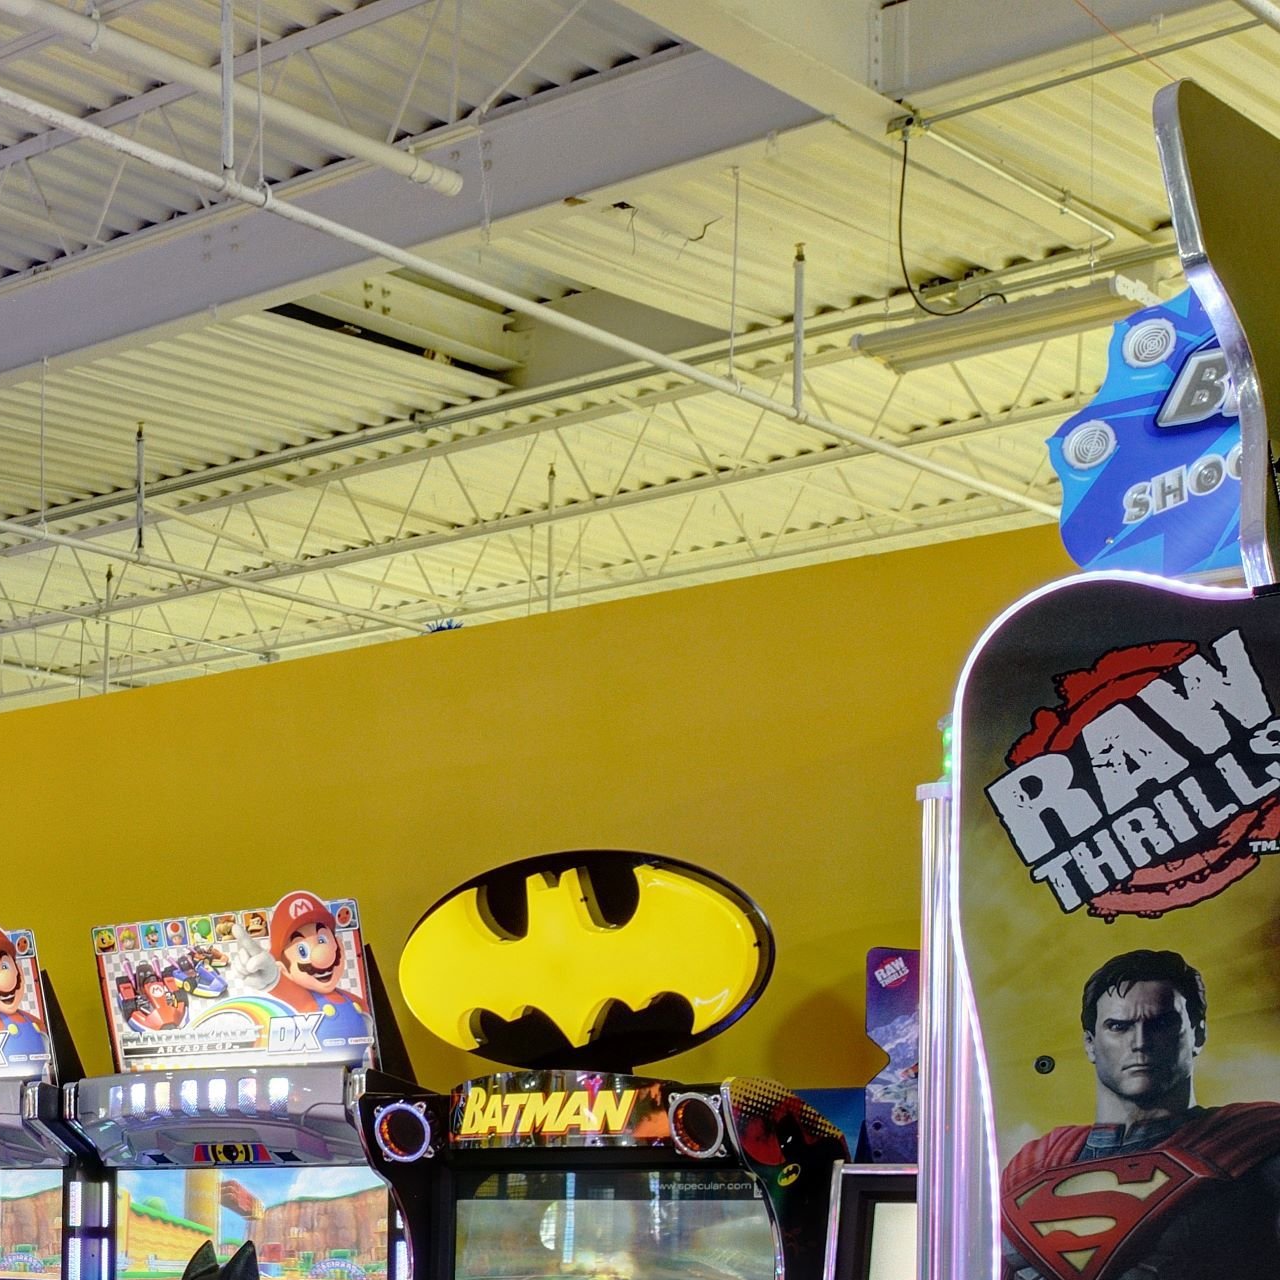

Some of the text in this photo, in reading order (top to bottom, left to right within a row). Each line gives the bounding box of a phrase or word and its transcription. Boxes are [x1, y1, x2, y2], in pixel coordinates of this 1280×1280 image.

[985, 628, 1274, 866] RAW
[874, 957, 905, 981] RAW
[157, 1044, 209, 1054] ARCADE
[267, 1012, 324, 1056] DX
[462, 1087, 637, 1136] BATMAN
